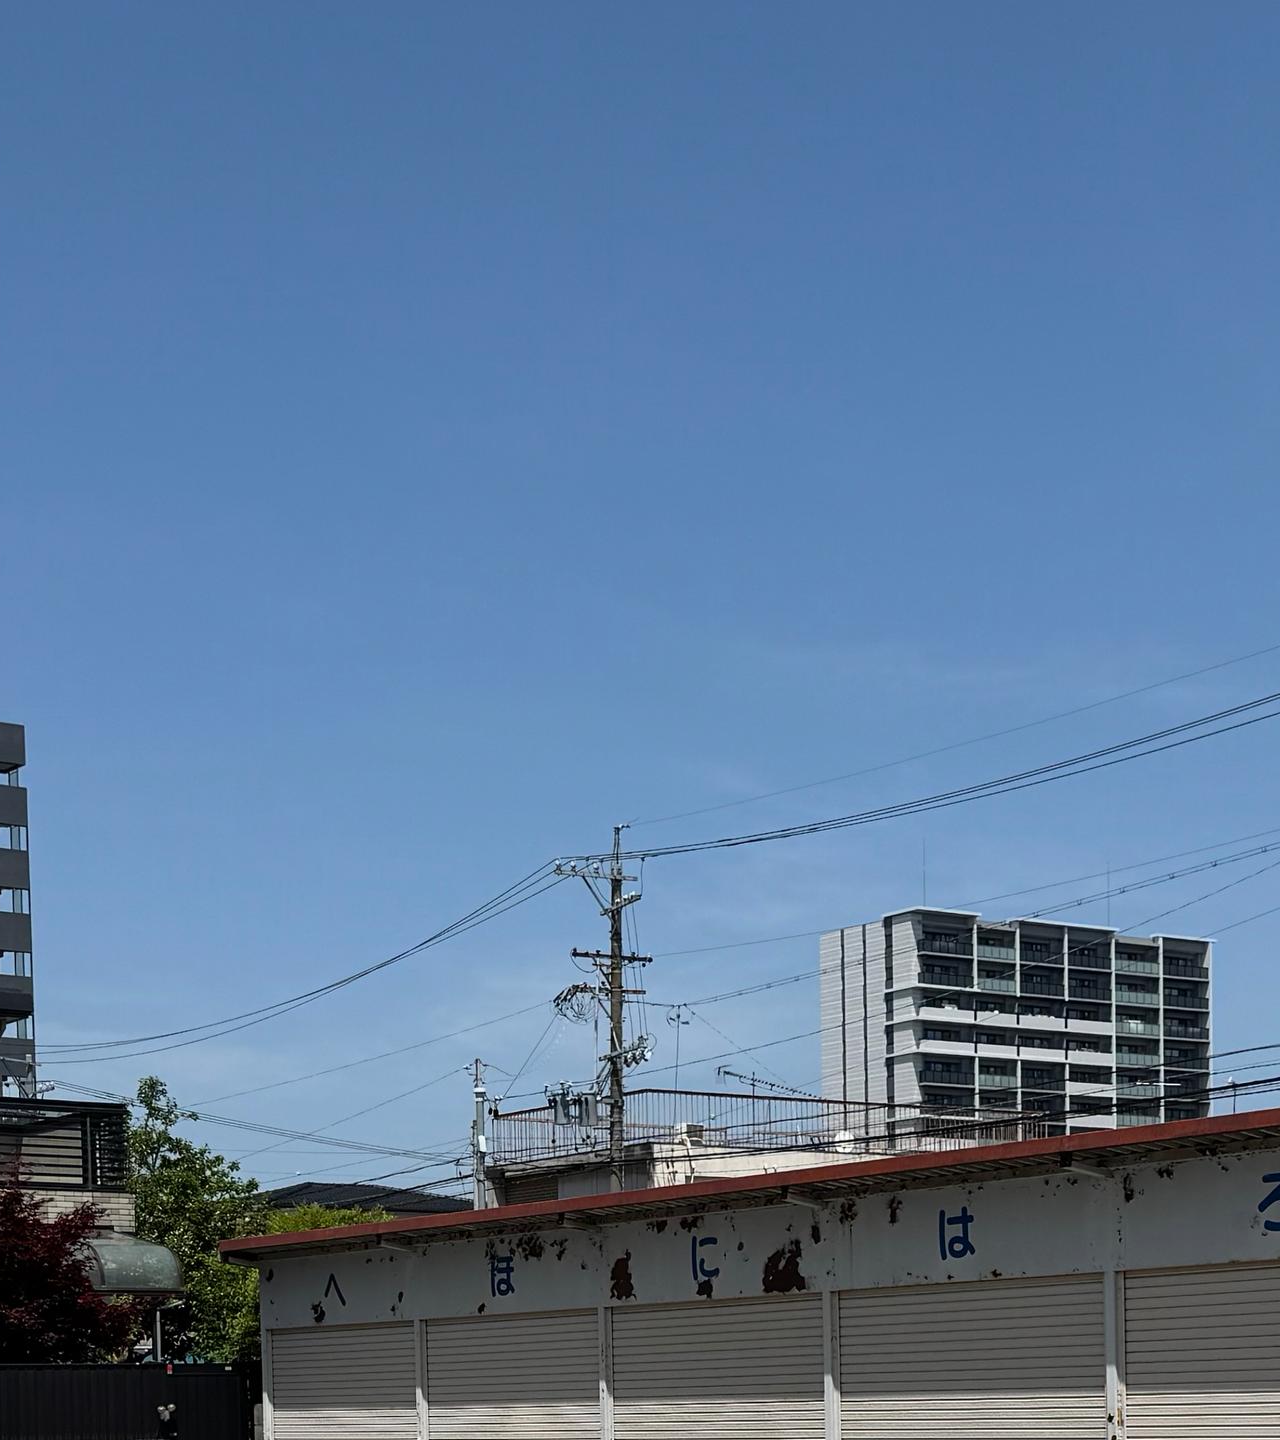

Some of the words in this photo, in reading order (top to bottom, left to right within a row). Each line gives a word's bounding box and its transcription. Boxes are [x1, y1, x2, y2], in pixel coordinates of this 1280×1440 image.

[939, 1206, 976, 1261] は
[490, 1255, 515, 1298] ほ
[692, 1235, 720, 1281] に
